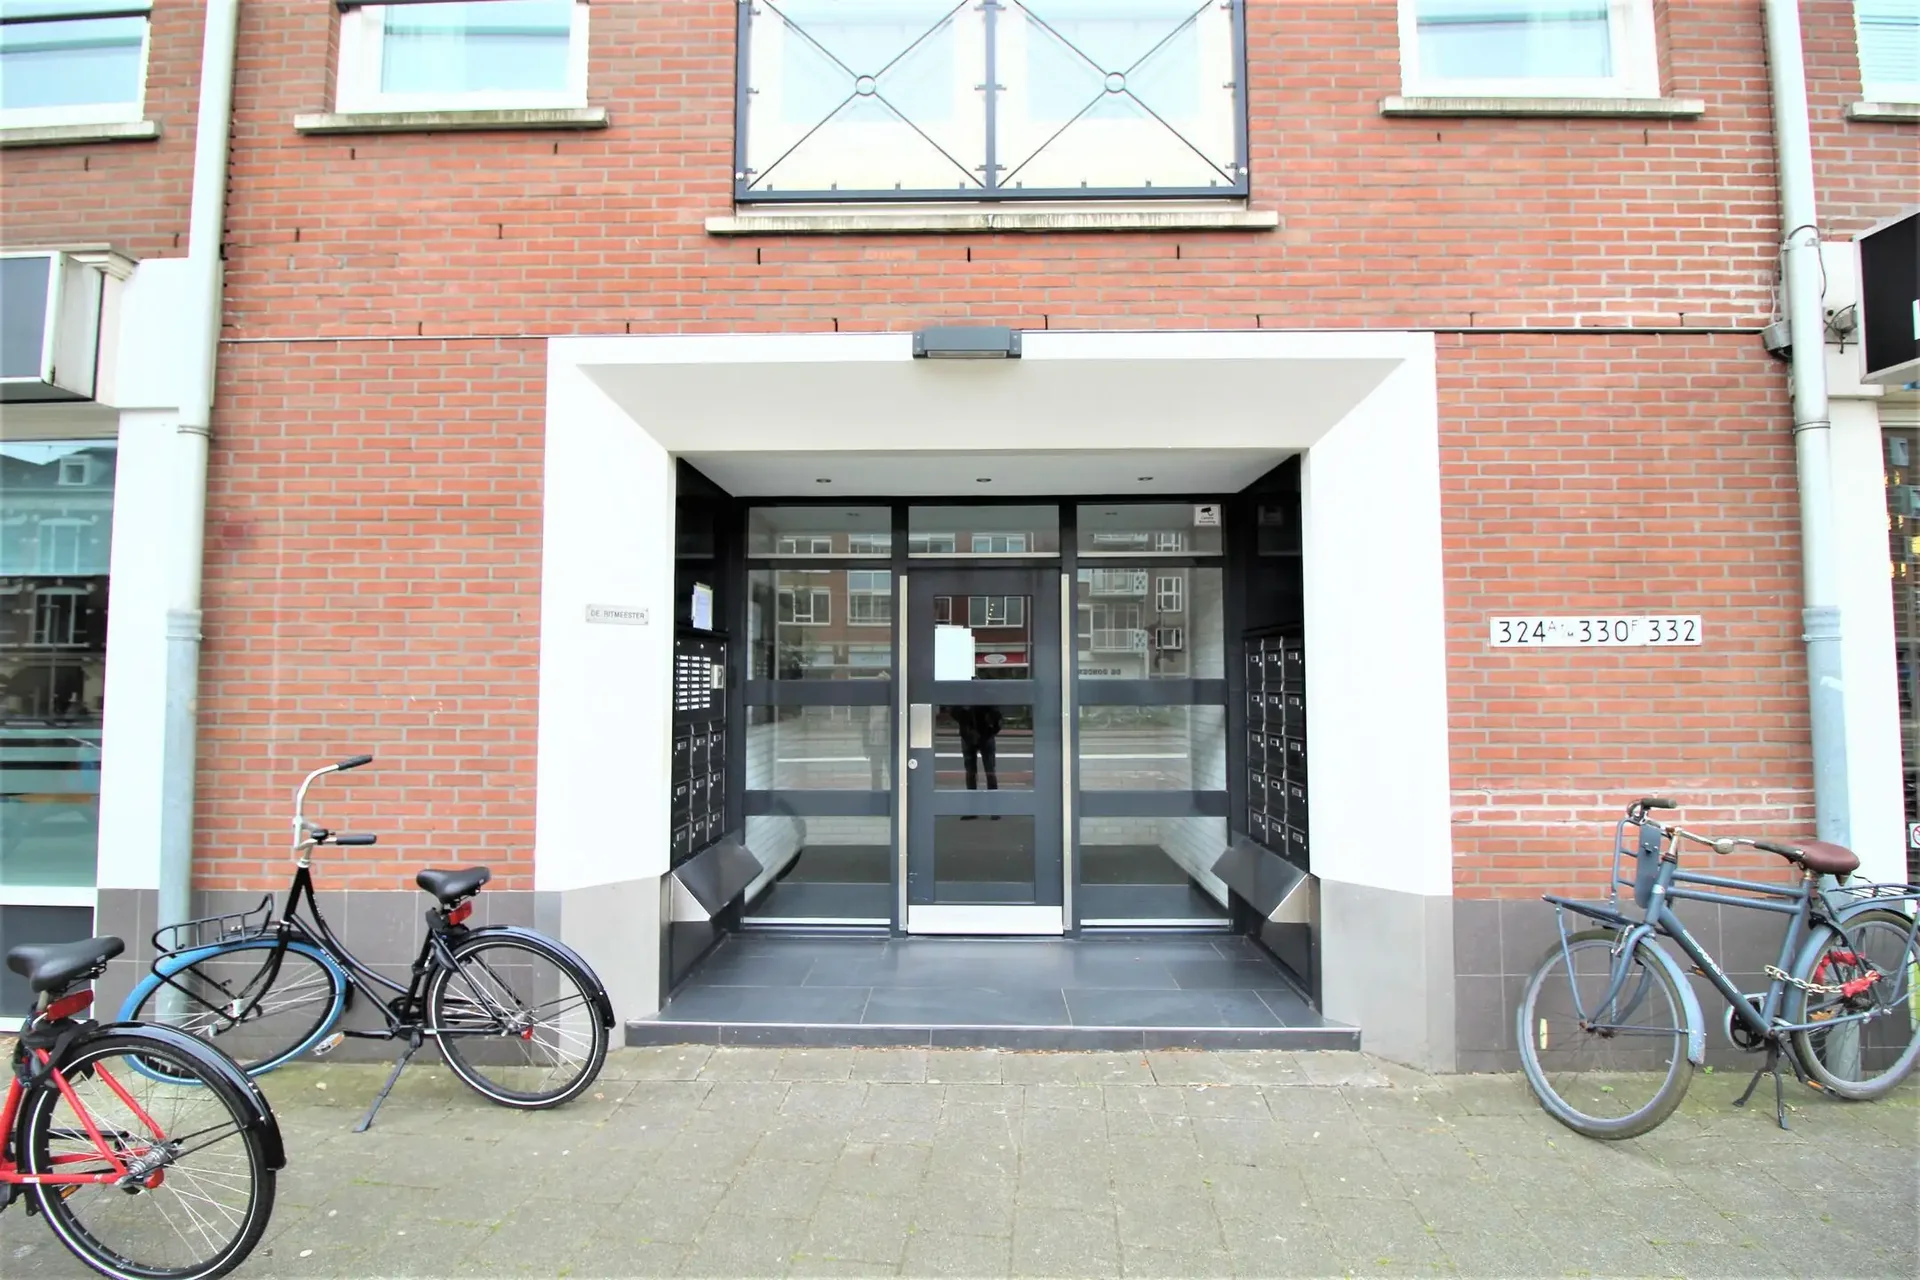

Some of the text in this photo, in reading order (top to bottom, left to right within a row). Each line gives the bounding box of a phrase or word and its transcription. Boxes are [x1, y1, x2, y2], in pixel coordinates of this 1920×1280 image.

[590, 609, 645, 619] DE RITMEESTER
[1649, 619, 1695, 642] 332
